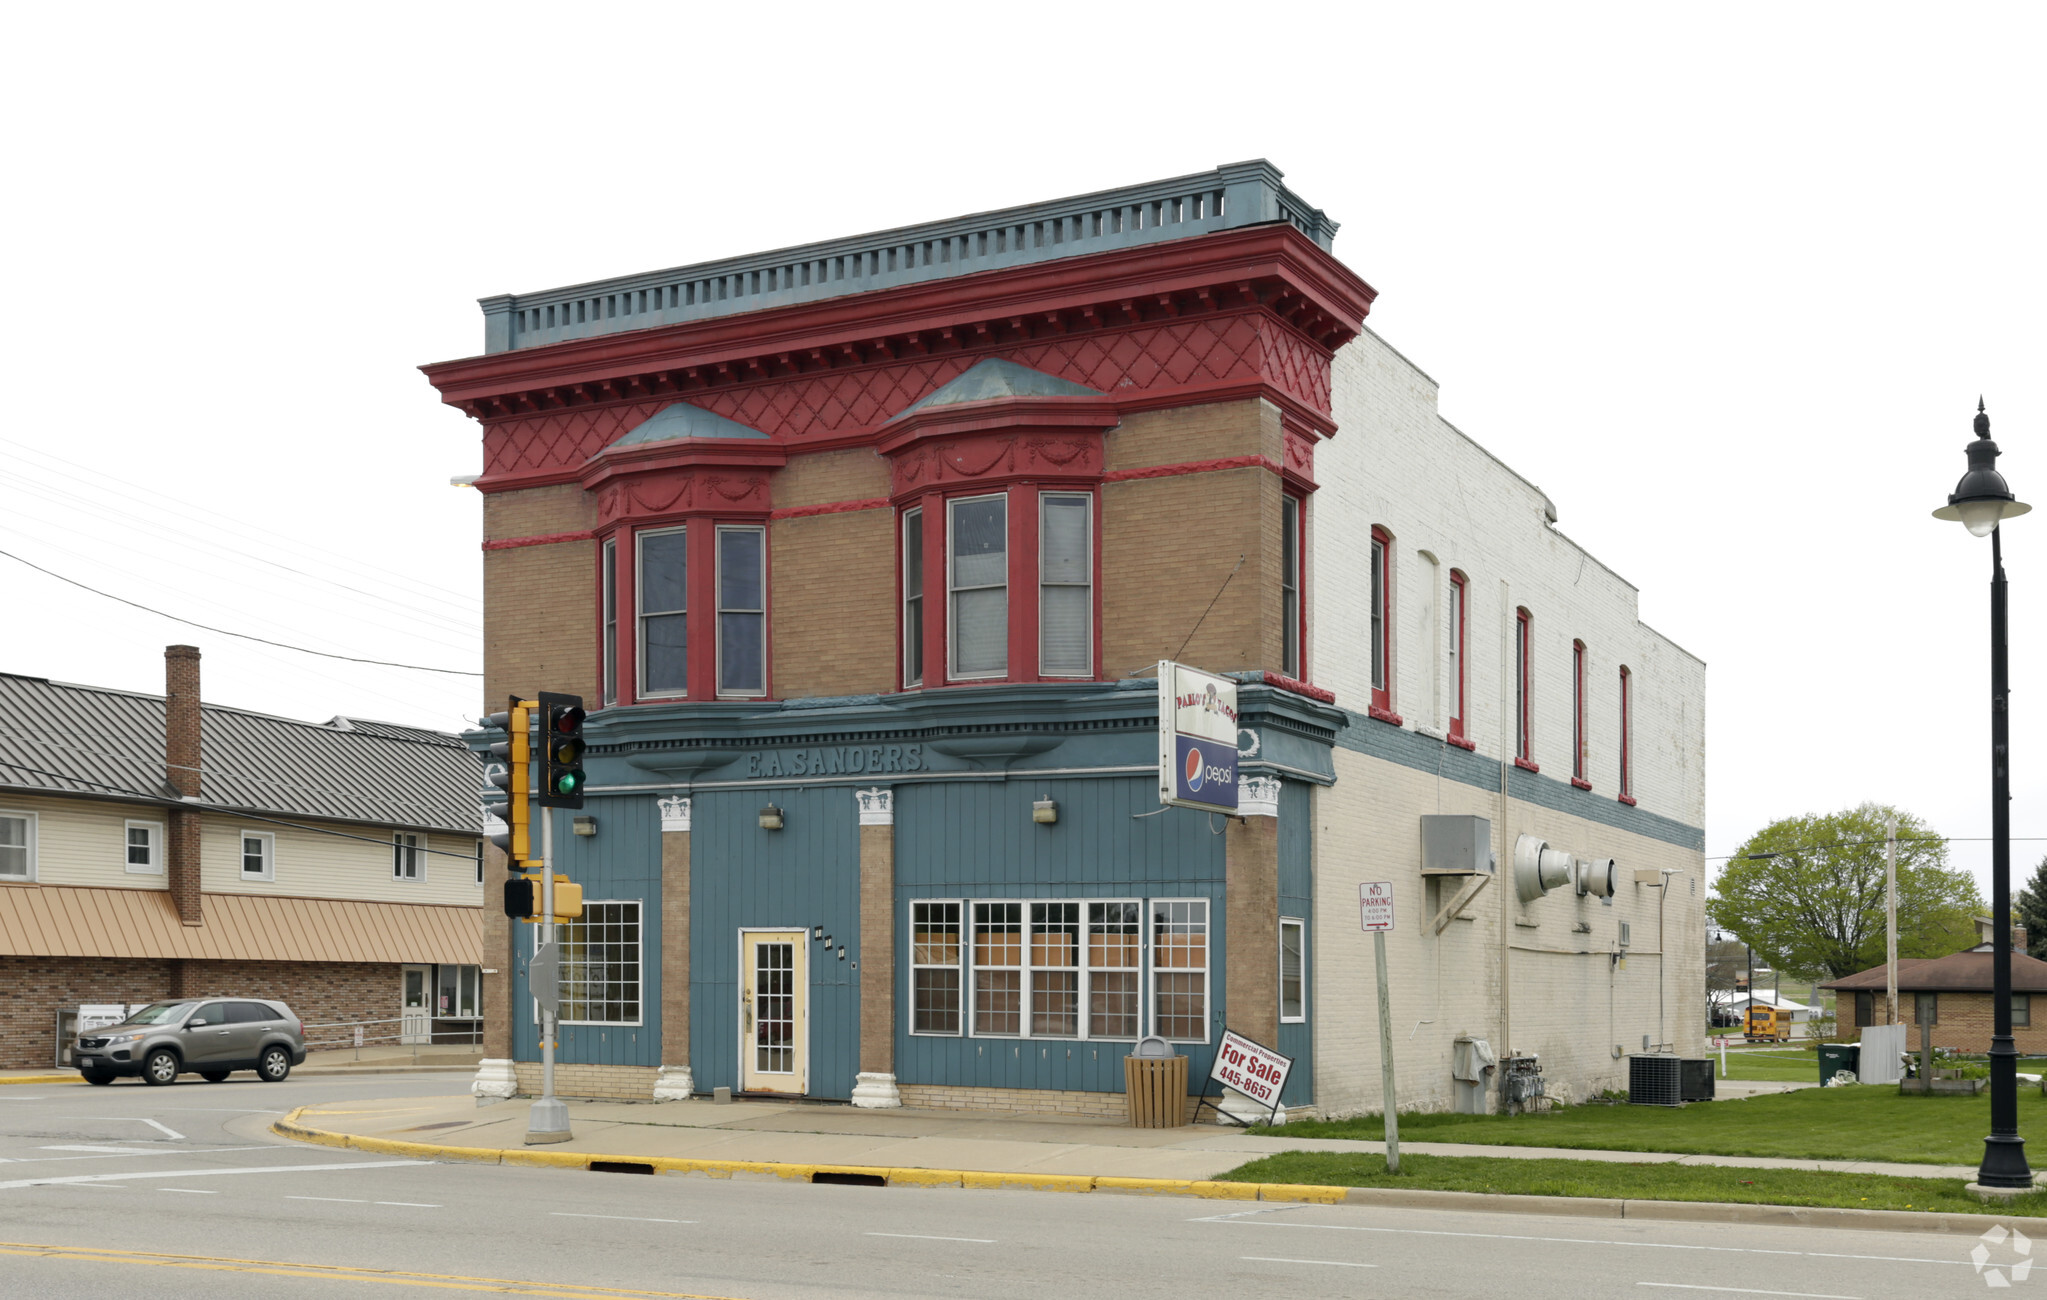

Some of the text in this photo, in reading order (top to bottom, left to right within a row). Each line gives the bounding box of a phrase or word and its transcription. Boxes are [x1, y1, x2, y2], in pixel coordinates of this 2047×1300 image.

[1205, 765, 1232, 786] pepsi
[1362, 897, 1391, 907] PARKING
[1370, 887, 1382, 896] NO
[1221, 1043, 1282, 1085] For Sale
[1226, 1034, 1287, 1068] Commercial Properties
[1220, 1066, 1272, 1100] 445-8657
